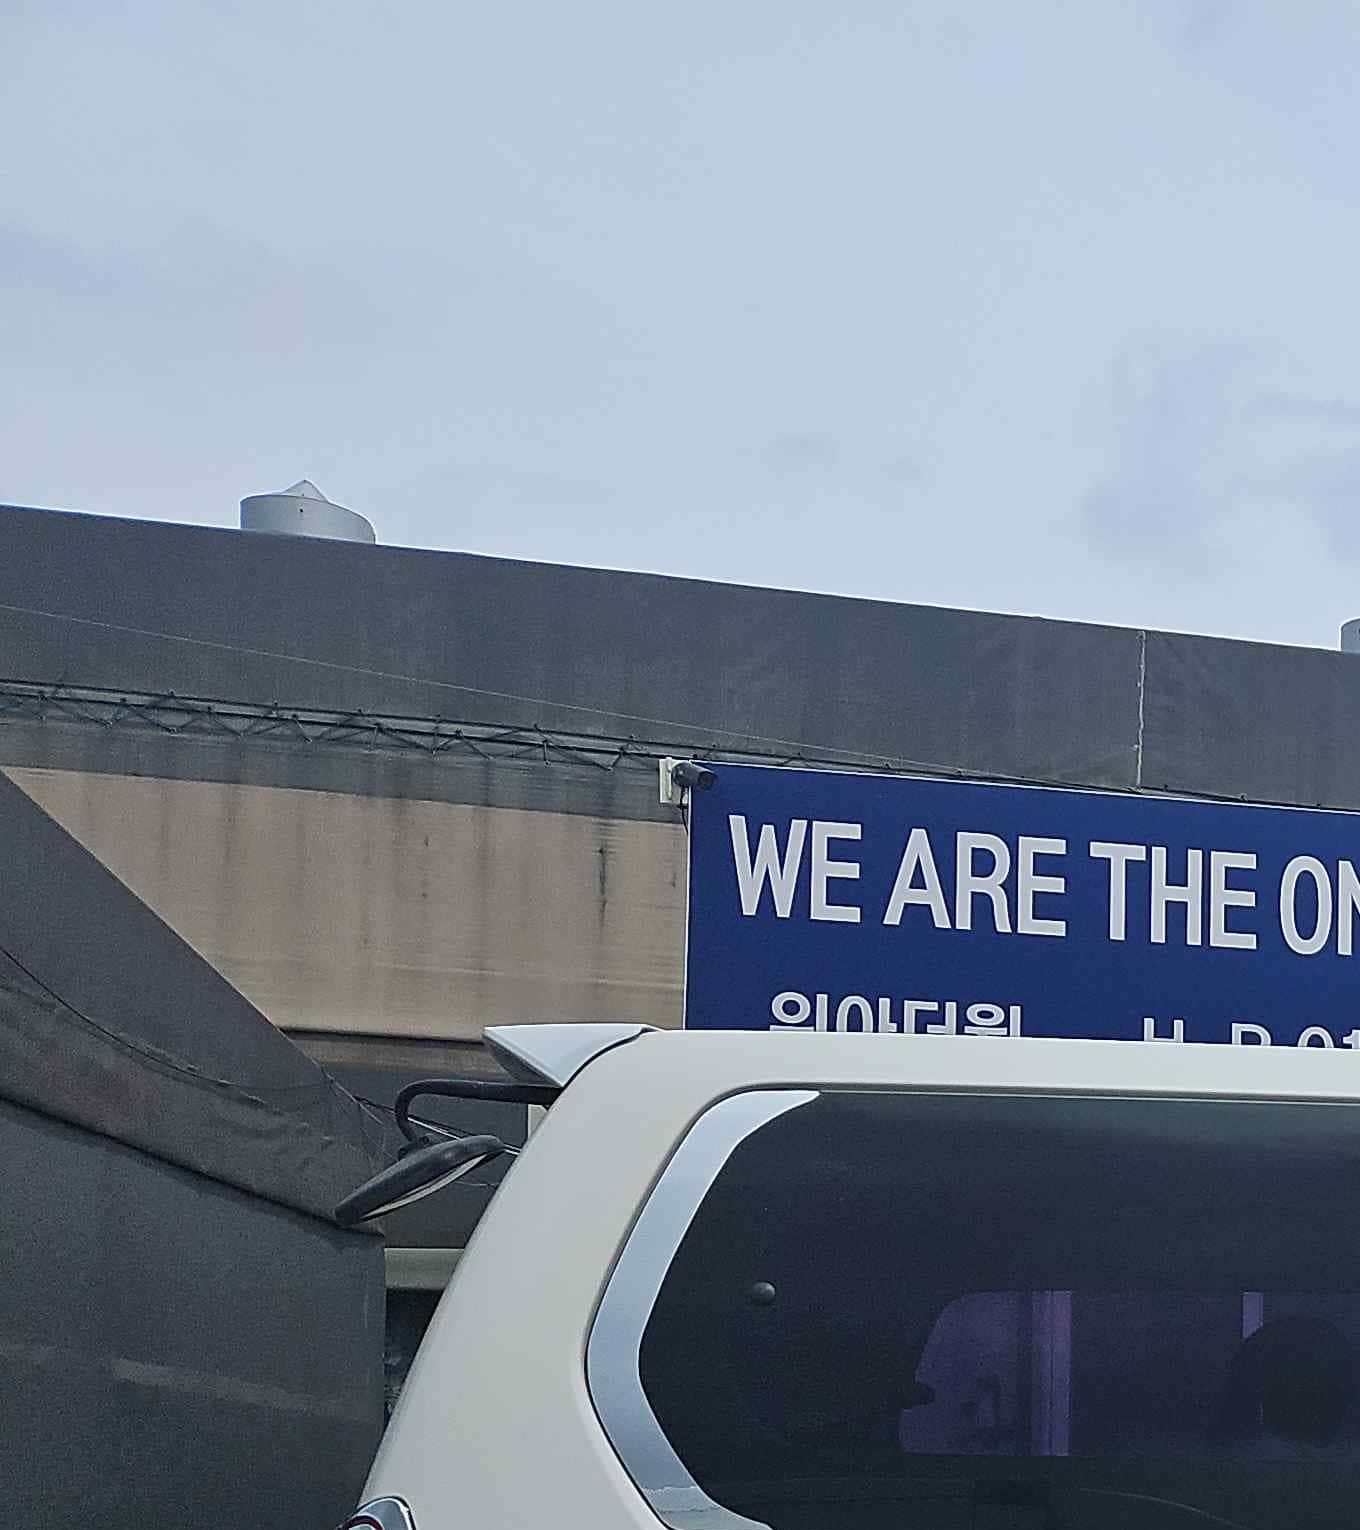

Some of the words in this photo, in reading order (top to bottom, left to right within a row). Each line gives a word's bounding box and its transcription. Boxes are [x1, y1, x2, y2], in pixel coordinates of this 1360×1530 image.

[729, 815, 861, 922] WE
[883, 829, 1066, 936] ARE
[1090, 842, 1256, 949] THE
